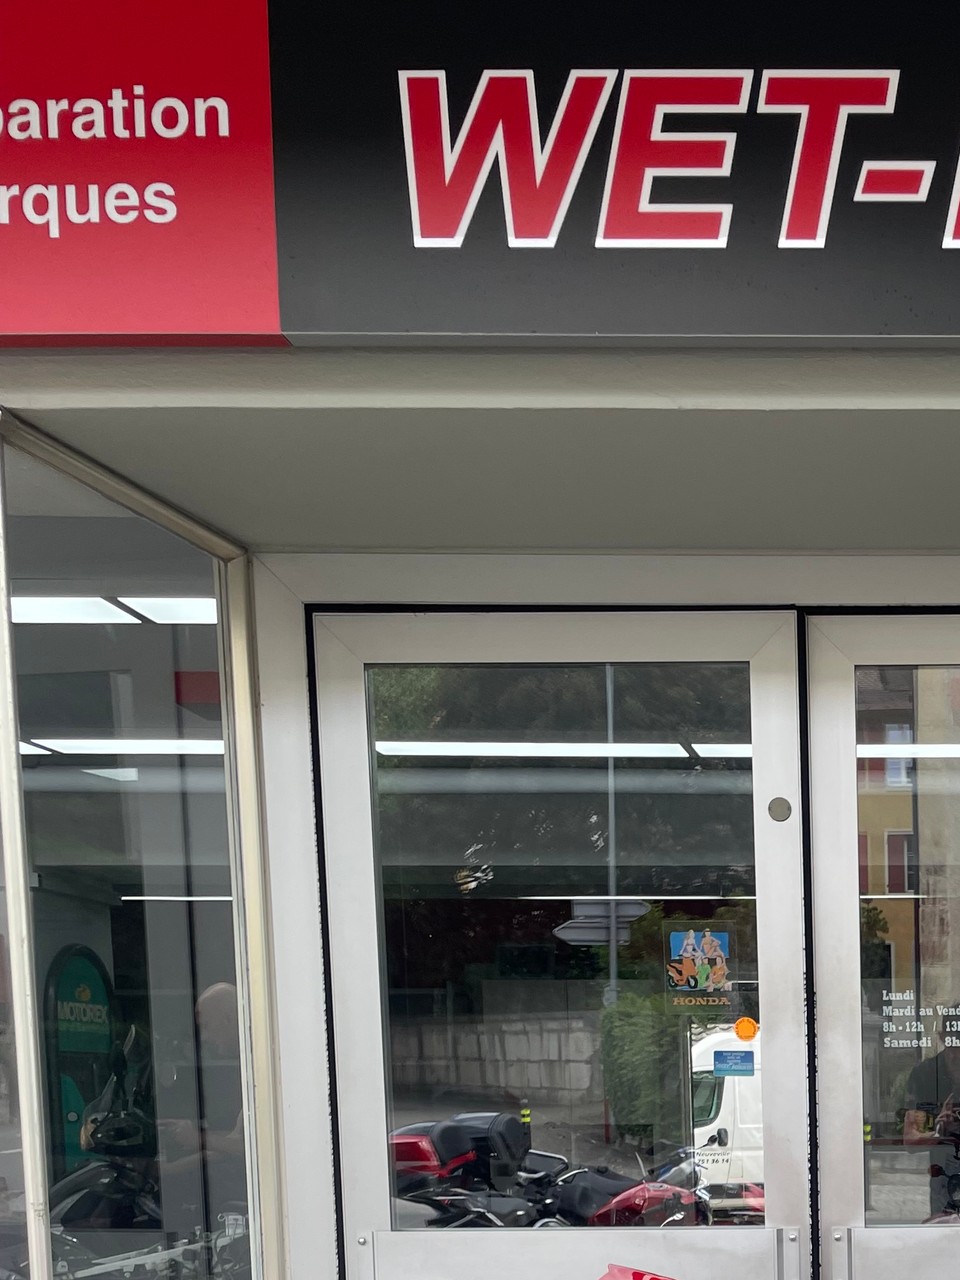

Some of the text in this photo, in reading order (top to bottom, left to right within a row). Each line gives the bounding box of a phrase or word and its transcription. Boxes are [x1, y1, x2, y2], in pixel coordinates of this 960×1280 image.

[0, 86, 230, 139] aration
[882, 990, 914, 1000] Lundi
[672, 997, 731, 1005] HONDA
[58, 1001, 108, 1023] MOTOREX
[882, 1006, 915, 1016] Mardi
[919, 1008, 933, 1016] au
[882, 1021, 896, 1032] 8h
[905, 1021, 924, 1032] 12h
[883, 1037, 932, 1048] Samedi
[944, 1036, 960, 1047] 8h
